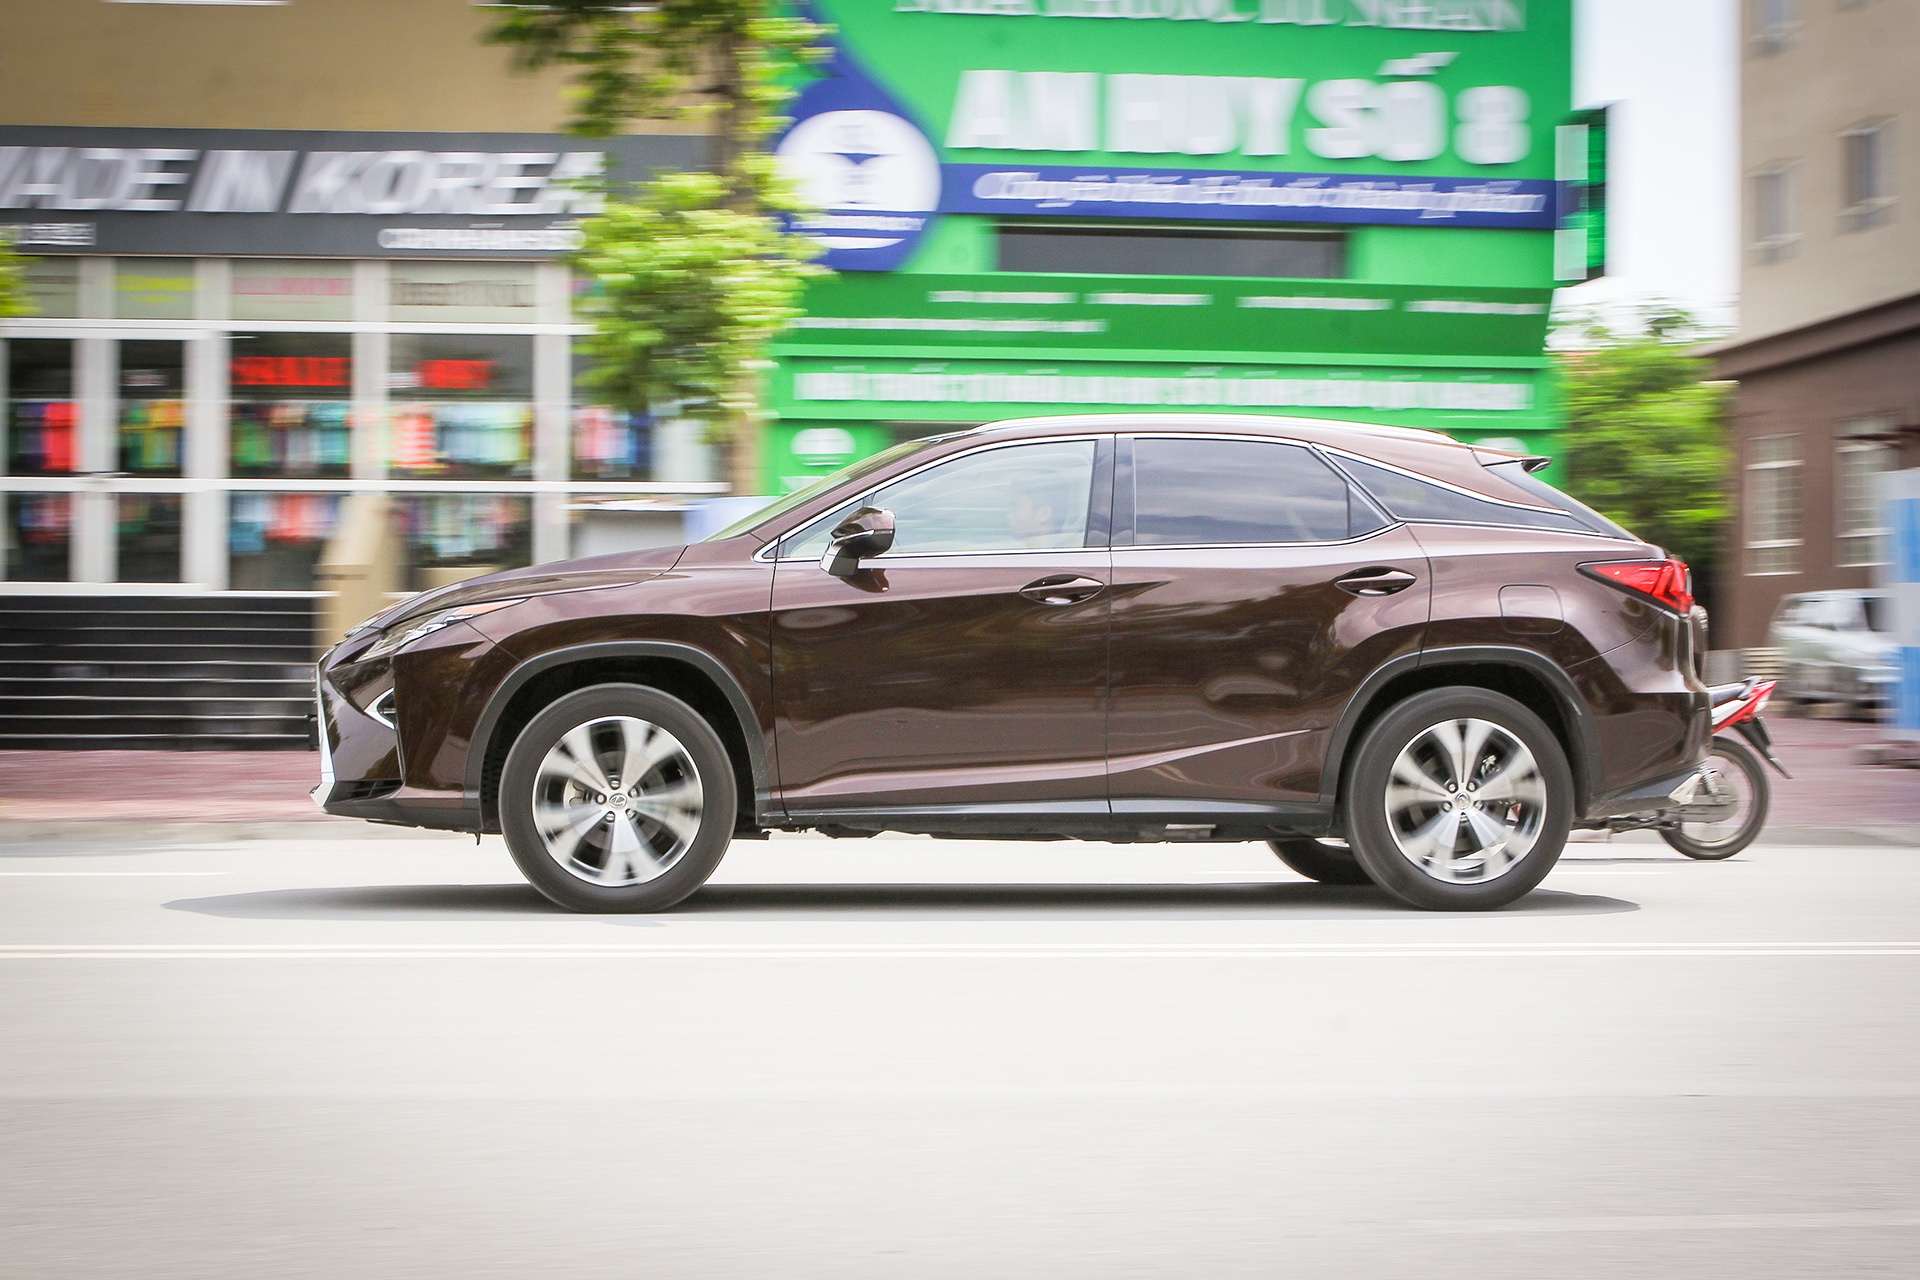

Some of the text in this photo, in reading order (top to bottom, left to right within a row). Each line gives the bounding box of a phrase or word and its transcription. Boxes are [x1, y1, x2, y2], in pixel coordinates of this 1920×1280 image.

[1455, 86, 1530, 164] 8
[0, 146, 607, 214] ADE IN KOREA
